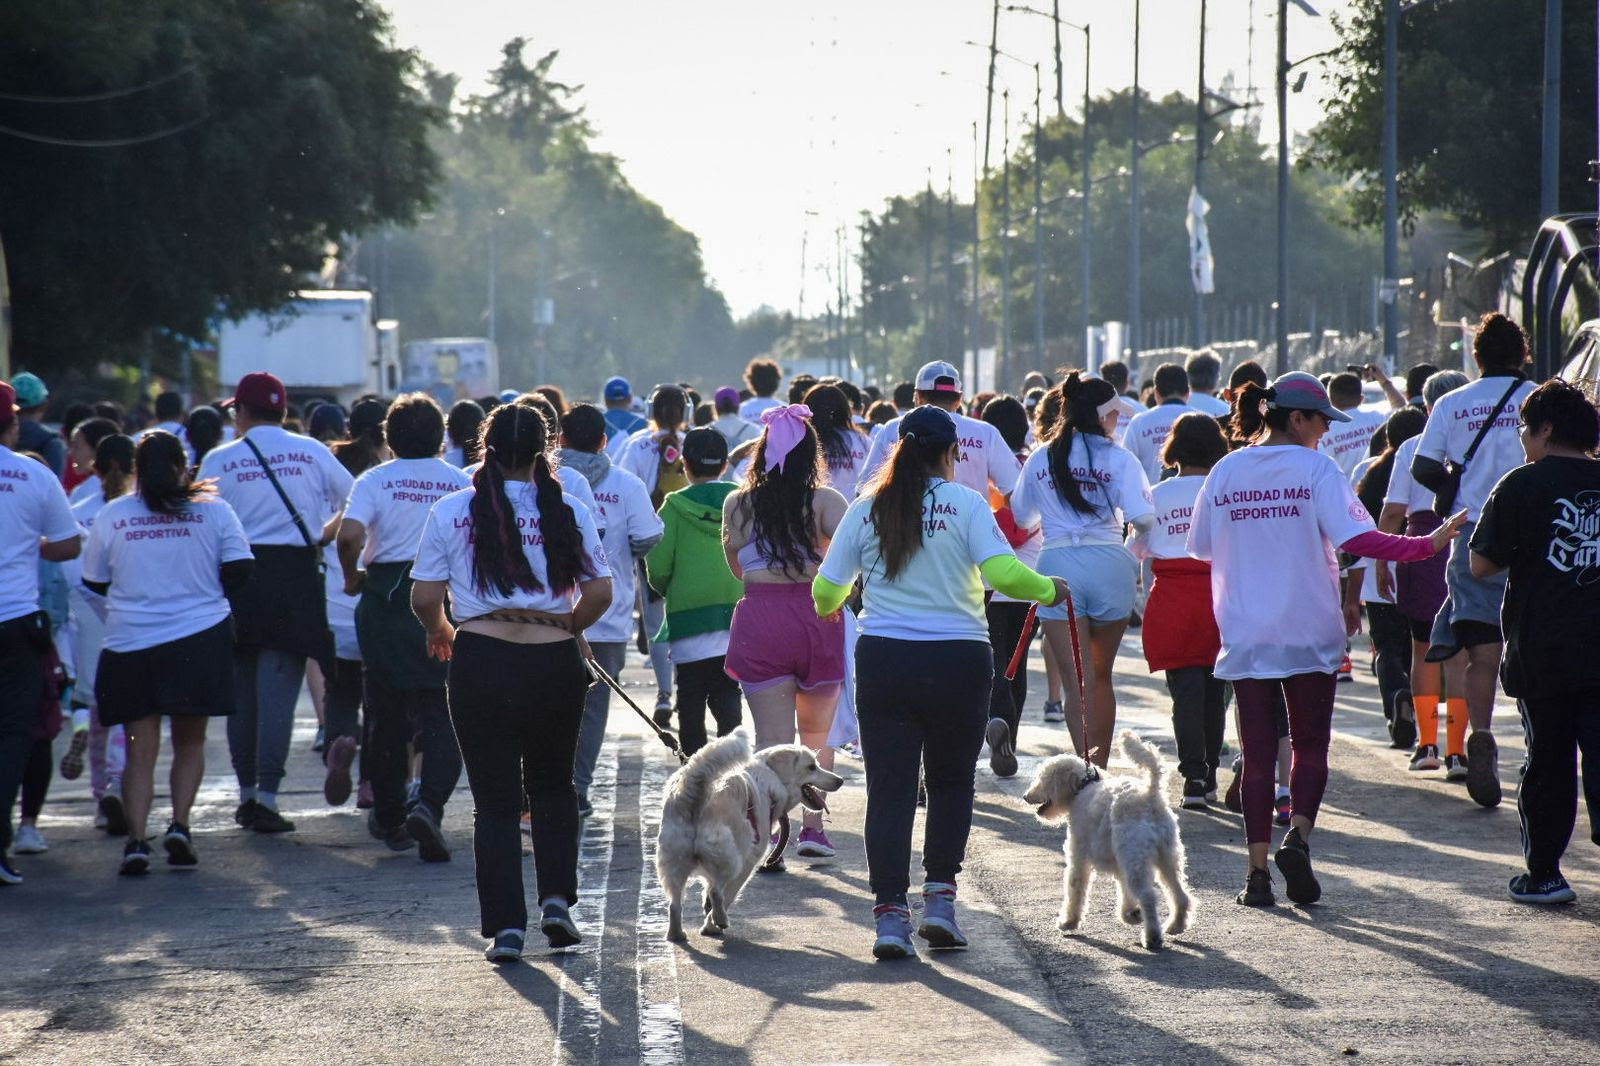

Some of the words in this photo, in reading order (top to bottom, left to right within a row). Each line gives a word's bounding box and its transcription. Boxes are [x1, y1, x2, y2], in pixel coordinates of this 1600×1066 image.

[1454, 409, 1469, 419] LA
[1472, 404, 1515, 416] CIUAD
[223, 461, 238, 472] LA
[241, 454, 285, 468] CIUAD
[237, 467, 302, 482] DEPOTIVA
[395, 479, 433, 490] CIUDAD
[594, 492, 619, 503] MÁS
[1214, 494, 1230, 506] LA
[1232, 489, 1281, 503] CIUDAD
[1284, 485, 1311, 500] MÁS
[1230, 505, 1300, 521] DEPORTIVA
[113, 519, 127, 530] LA
[130, 514, 174, 526] CIUDAD
[453, 517, 471, 528] LA
[125, 528, 190, 541] DEPORTIVA
